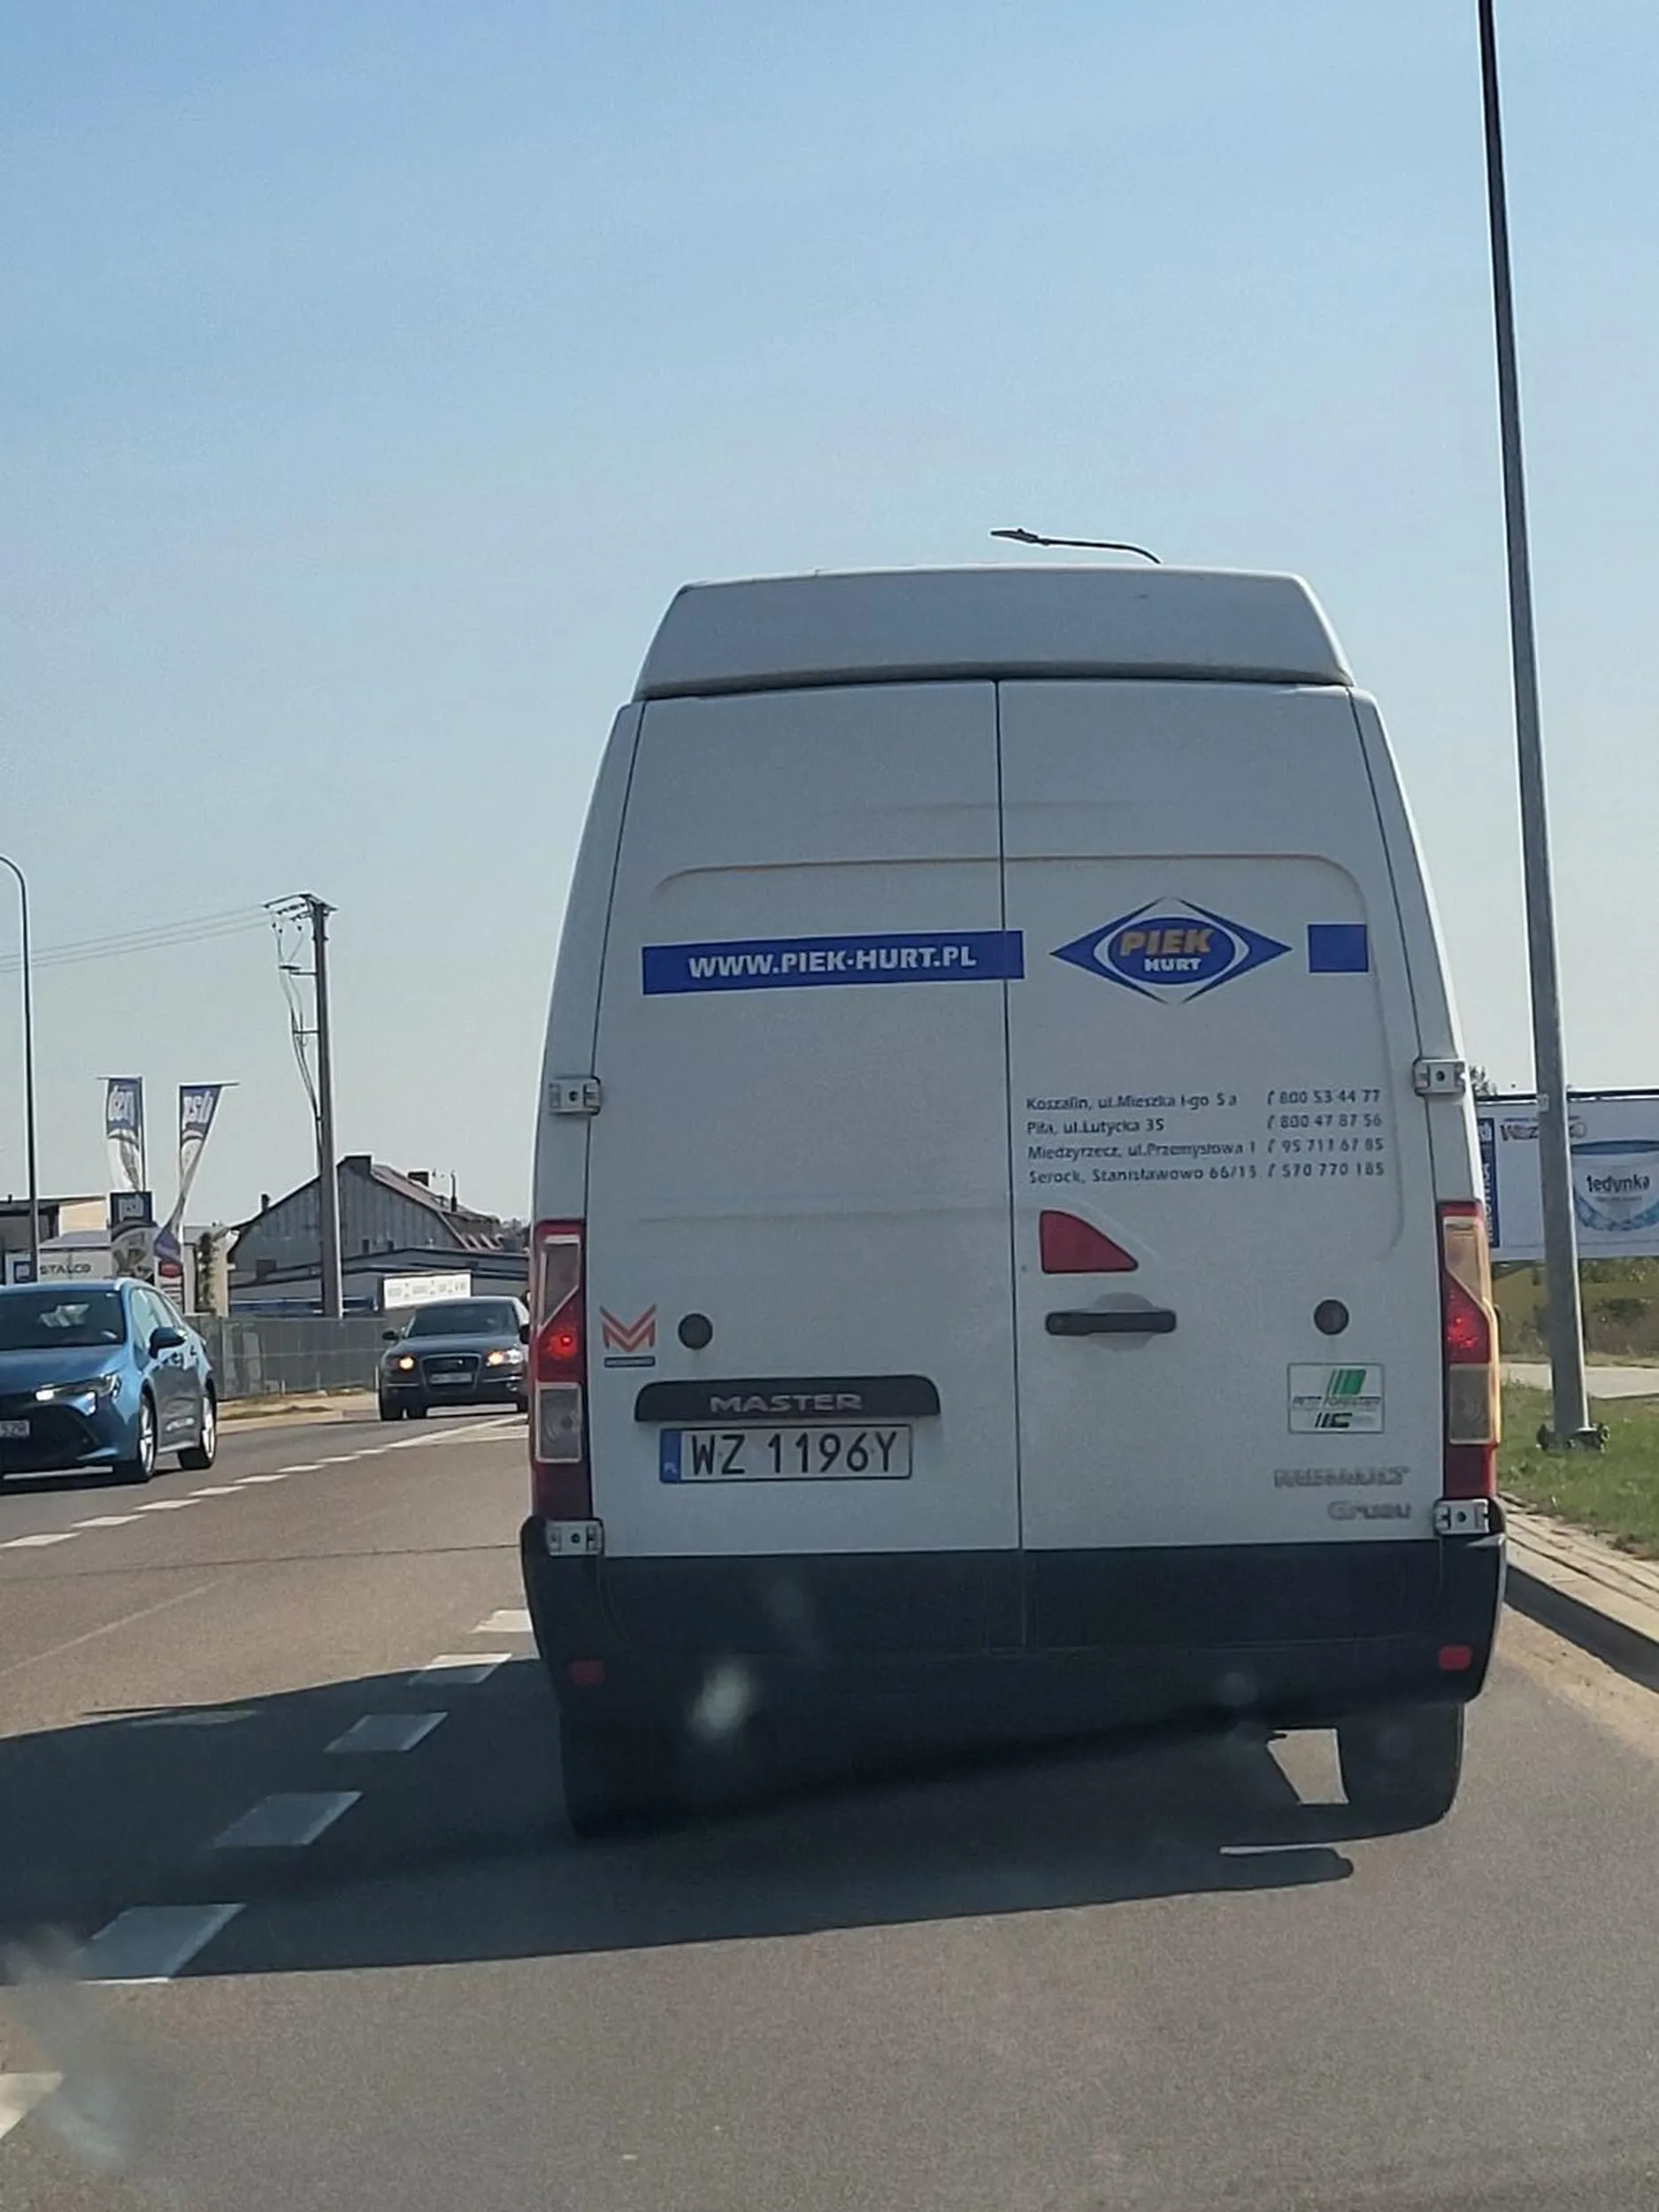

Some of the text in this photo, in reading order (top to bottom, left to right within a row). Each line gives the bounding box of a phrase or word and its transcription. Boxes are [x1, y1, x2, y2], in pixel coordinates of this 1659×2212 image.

[1119, 928, 1214, 956] PIEK
[688, 945, 977, 979] WWW.PIEK-HURT.PL
[1145, 957, 1202, 972] HURT
[1362, 1089, 1380, 1102] 77
[1318, 1163, 1348, 1177] 770
[710, 1394, 862, 1413] MASTER
[691, 1431, 897, 1475] WZ 1196Y
